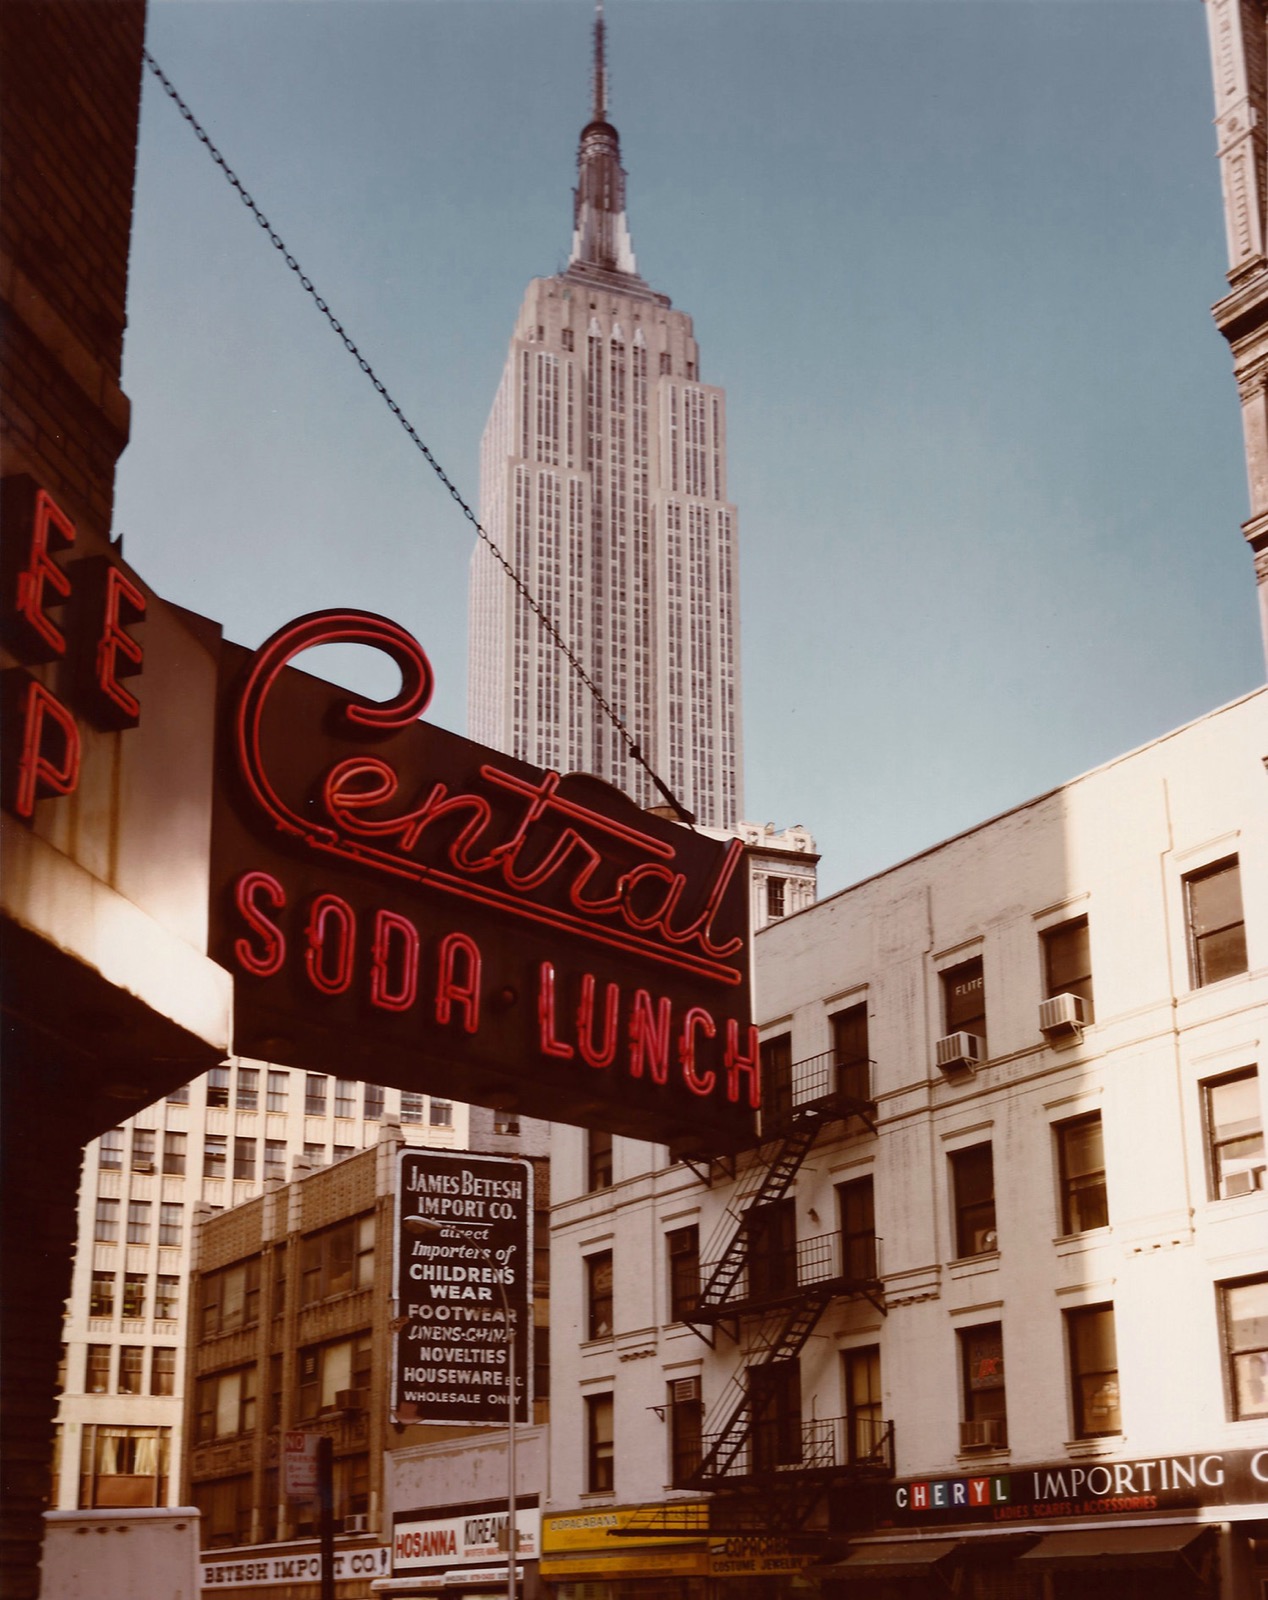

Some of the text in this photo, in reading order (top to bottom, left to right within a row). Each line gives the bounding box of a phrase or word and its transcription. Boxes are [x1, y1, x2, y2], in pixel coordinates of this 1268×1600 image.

[237, 611, 745, 956] Central
[234, 870, 762, 1108] SODA LUNCH
[418, 1196, 518, 1220] IMPORT CO.
[440, 1224, 490, 1240] direct
[411, 1240, 517, 1265] Importers of
[409, 1263, 515, 1285] CHILDREN'S
[430, 1284, 493, 1301] WEAR
[408, 1304, 518, 1323] FOOTWEAR
[420, 1347, 507, 1364] NOVELTIES
[404, 1367, 503, 1386] HOUSEWARE
[404, 1390, 481, 1403] WHOLESALE
[286, 1435, 304, 1449] NO
[895, 1479, 1008, 1508] CHERYL
[1033, 1455, 1225, 1501] IMPORTING
[1033, 1502, 1072, 1517] SCARFS
[1083, 1495, 1158, 1514] ACCESSORIES
[551, 1514, 618, 1531] COPACABANA
[395, 1529, 457, 1559] HOSANNA
[204, 1563, 269, 1584] BETESH
[273, 1555, 344, 1579] IMPOT
